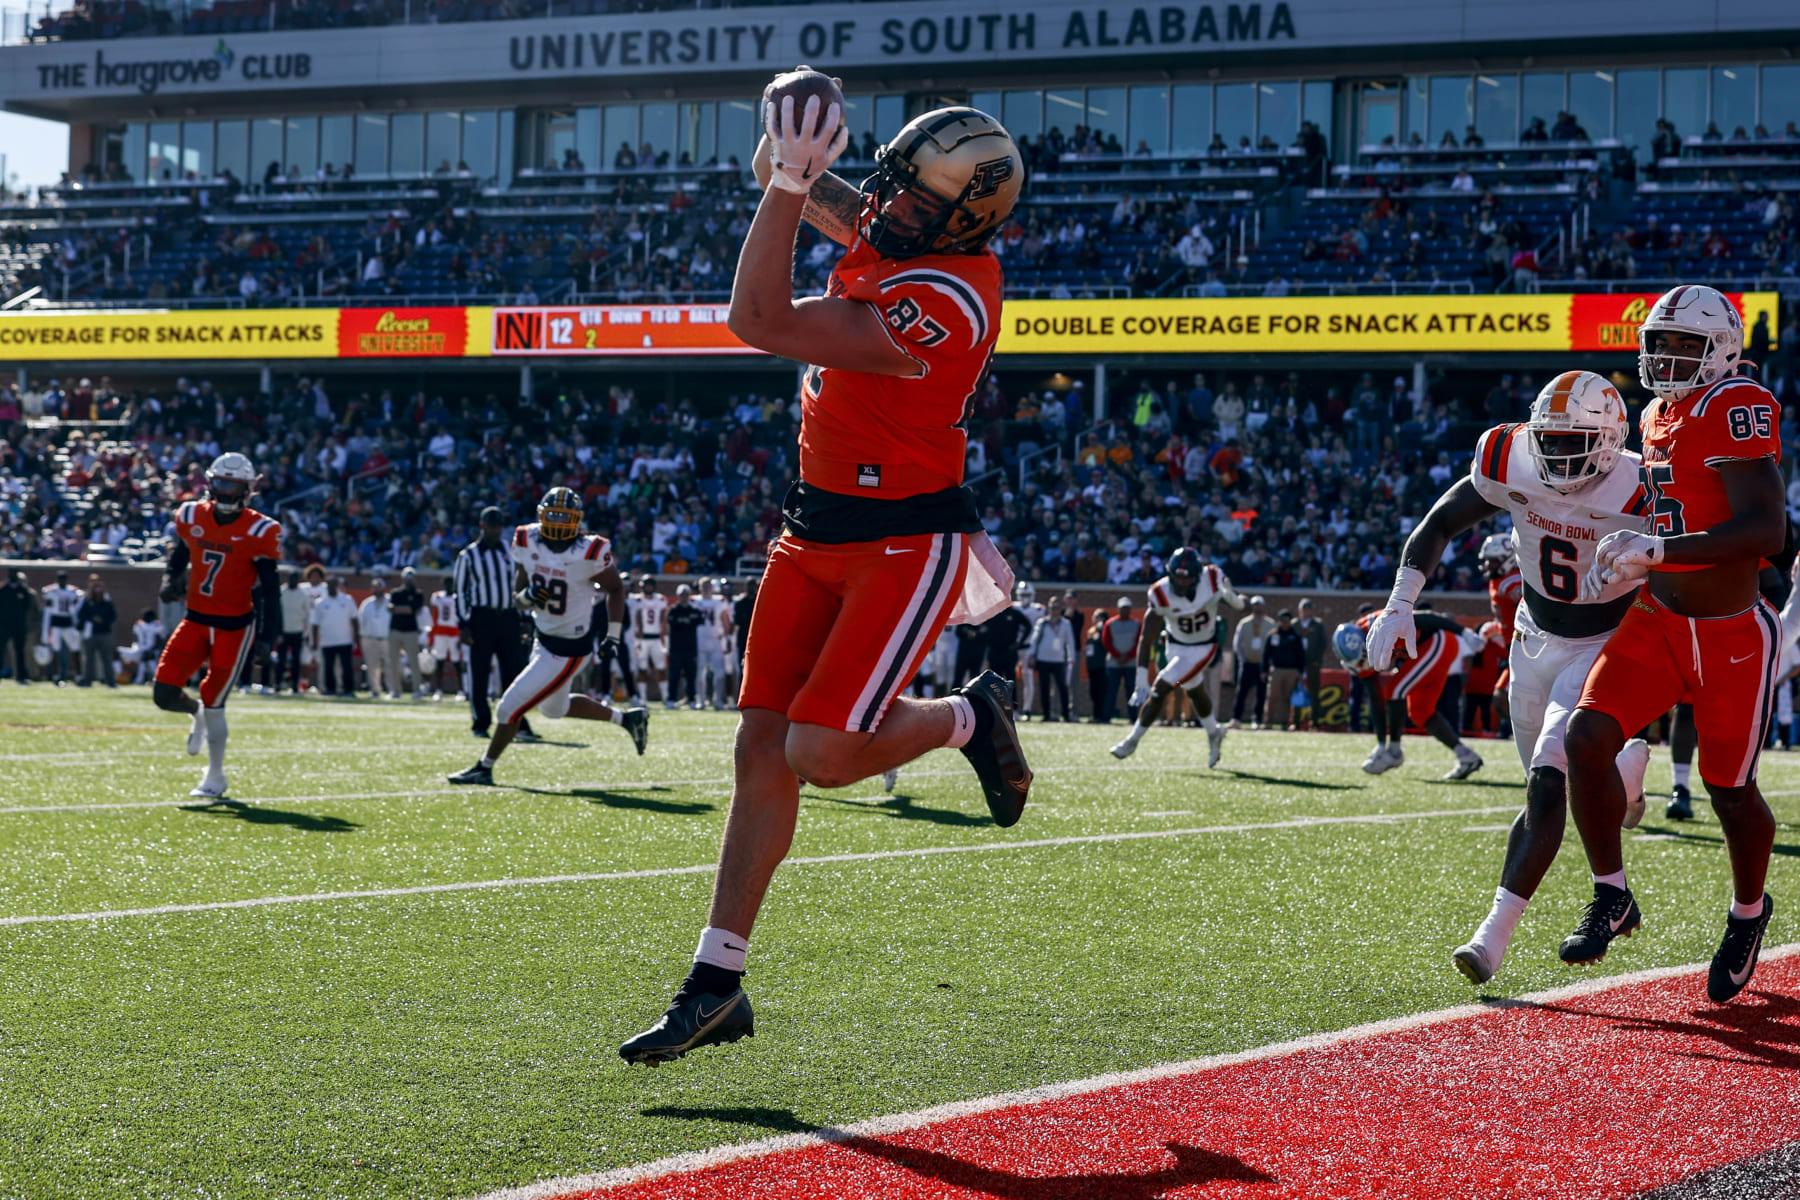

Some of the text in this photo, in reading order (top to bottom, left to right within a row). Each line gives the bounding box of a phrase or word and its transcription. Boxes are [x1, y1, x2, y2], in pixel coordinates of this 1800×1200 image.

[510, 1, 1297, 71] UNIVERSITY OF SOUTH ALABAMA
[38, 48, 311, 95] THE hargrove CLUB
[967, 155, 1015, 202] P
[0, 324, 323, 345] COVERAGE FOR SNACK ATTACKS
[550, 317, 573, 345] 12
[886, 297, 952, 347] 87
[1015, 313, 1551, 336] DOUBLE COVERAGE FOR SNACK ATTACKS
[359, 335, 445, 353] UNIVERSITY
[585, 328, 597, 349] 2
[1726, 405, 1773, 441] 85
[863, 466, 876, 475] XL
[1527, 511, 1598, 542] SENIOR BOWL
[200, 548, 226, 597] 7
[1540, 534, 1578, 604] 6
[1177, 608, 1211, 635] 92
